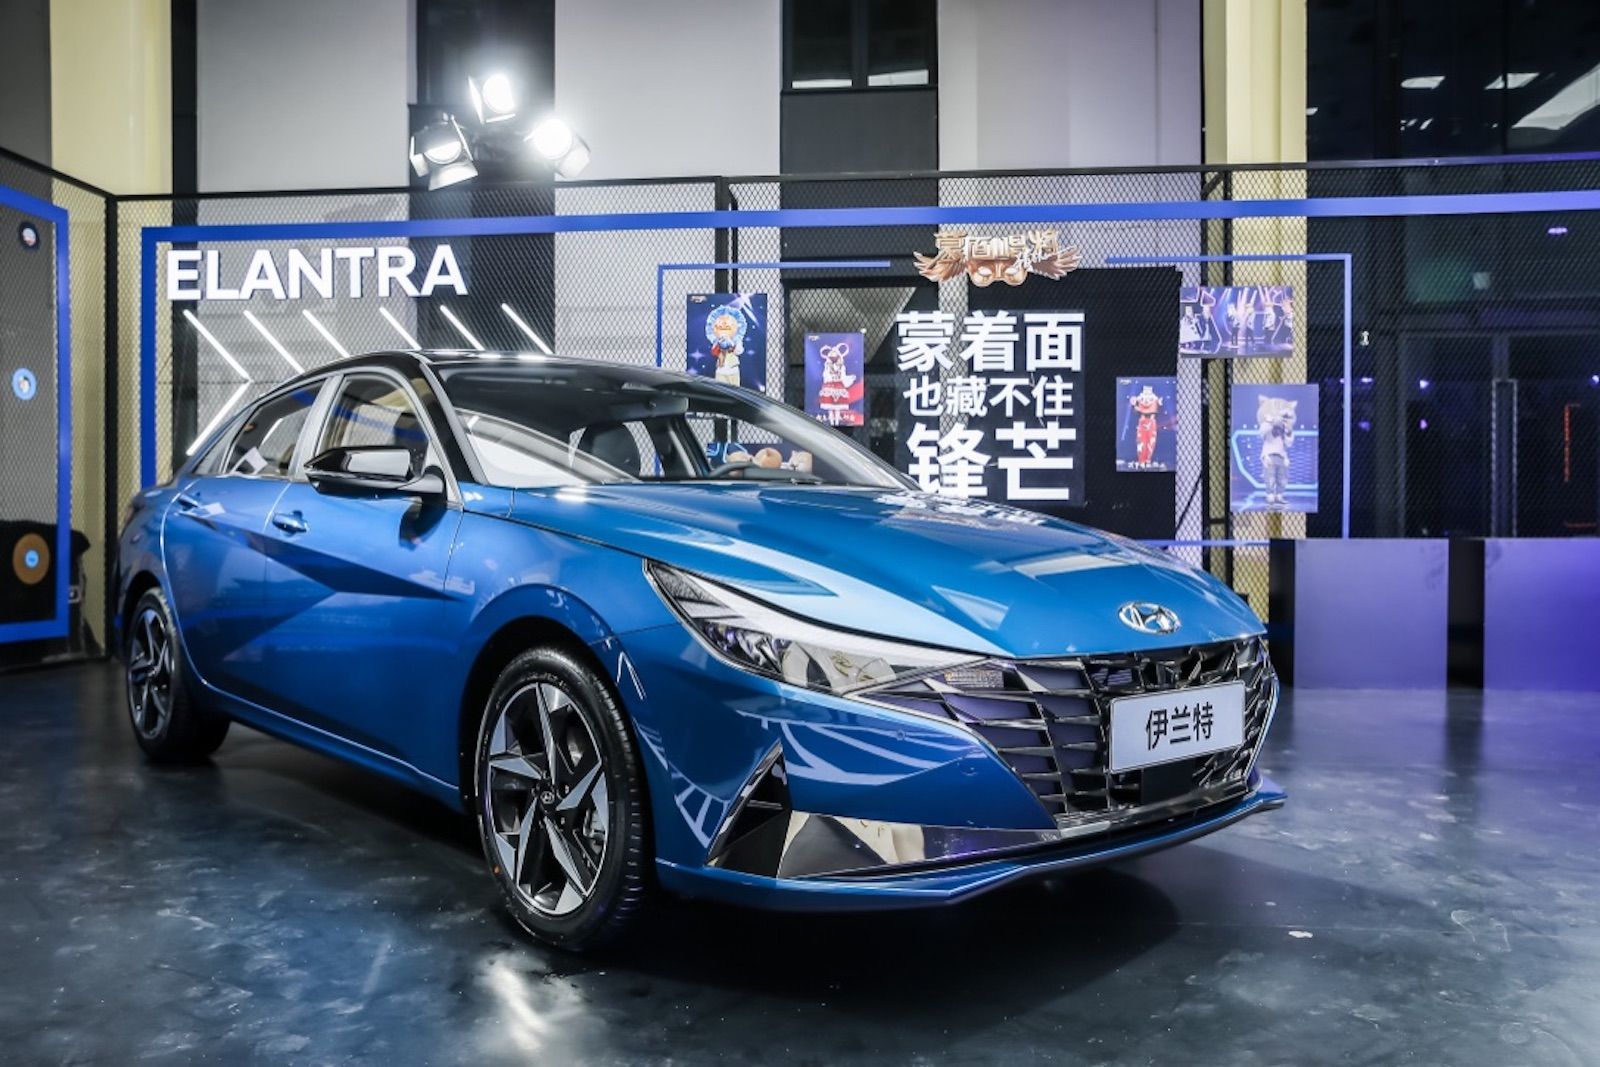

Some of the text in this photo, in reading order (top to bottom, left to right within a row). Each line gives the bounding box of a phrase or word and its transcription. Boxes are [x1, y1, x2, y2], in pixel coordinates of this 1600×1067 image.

[166, 244, 469, 300] ELANTRA
[896, 310, 1085, 372] 蒙着面
[903, 375, 1074, 417] 也藏不住
[906, 421, 1077, 500] 锋芒
[1146, 701, 1214, 750] 伊兰特
